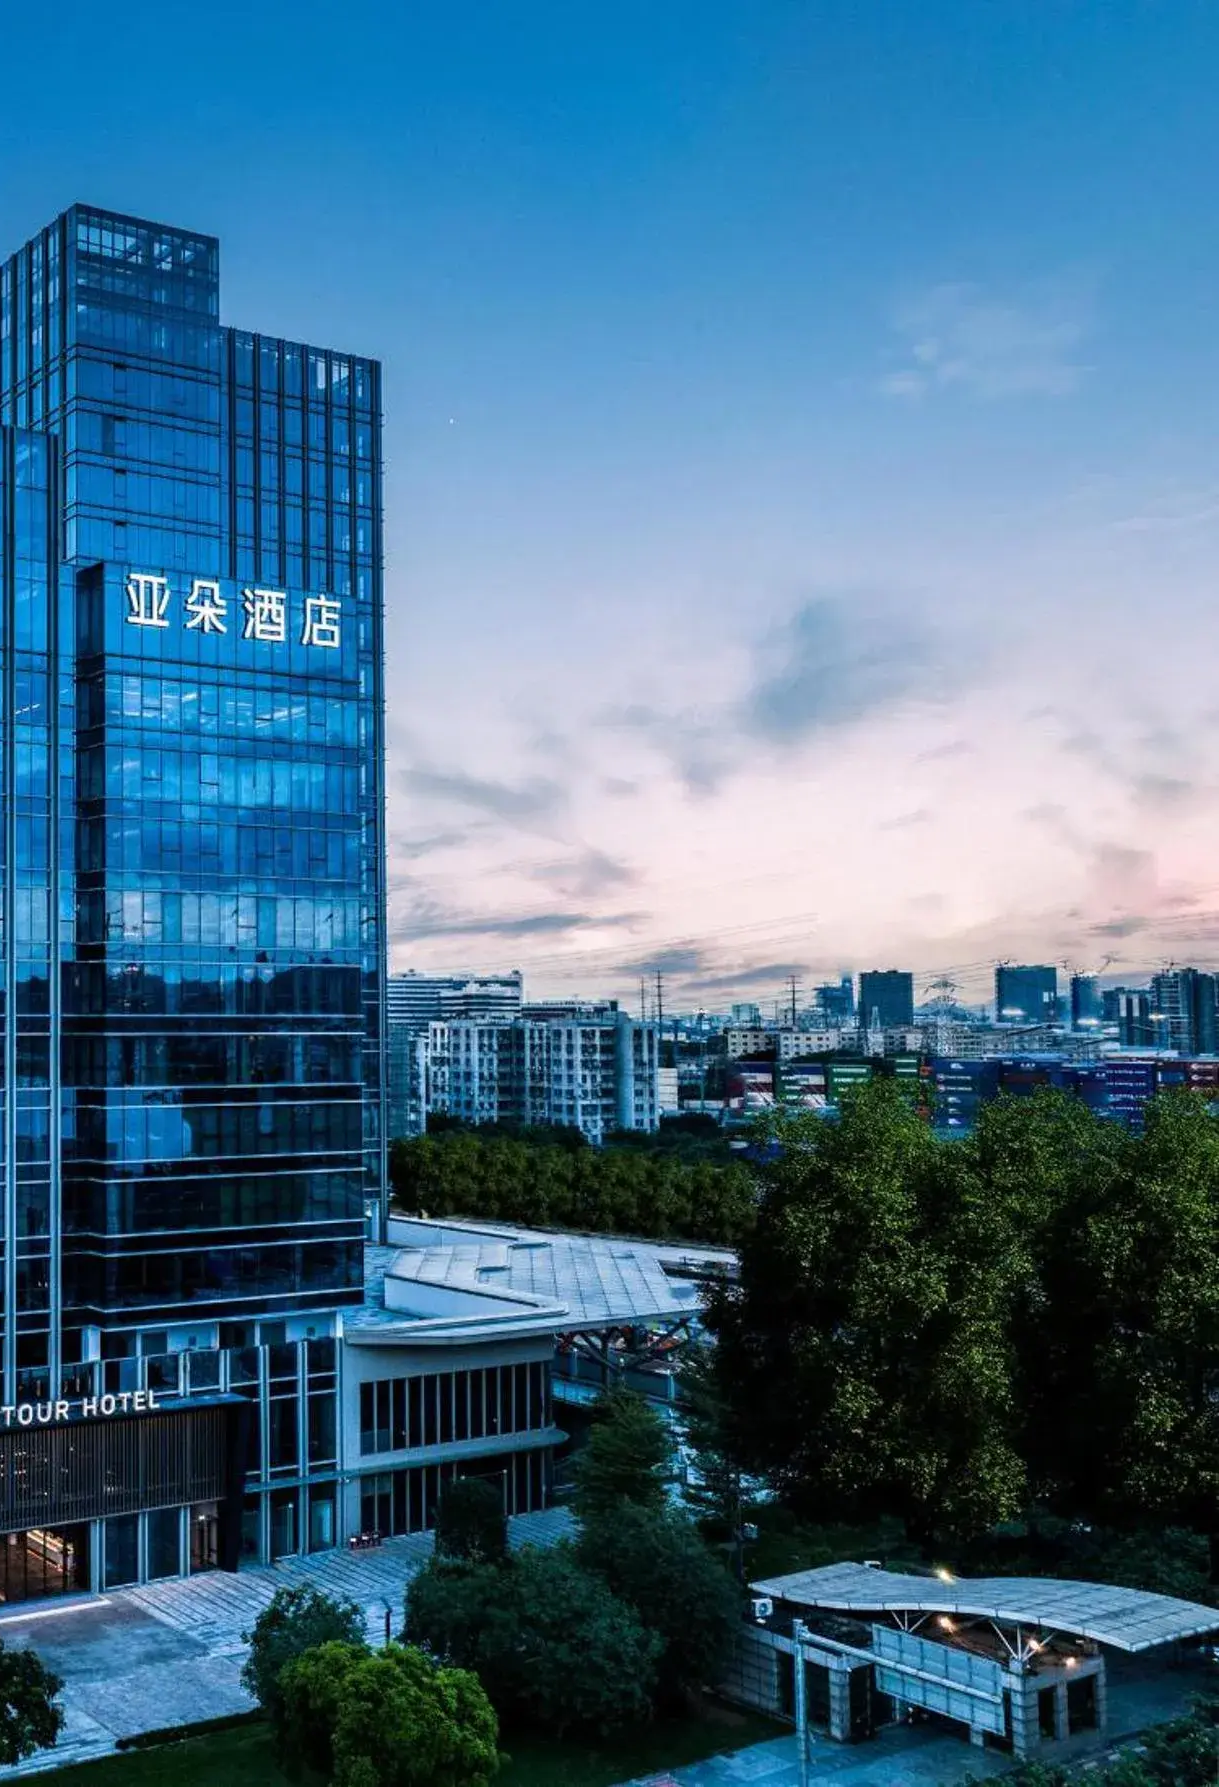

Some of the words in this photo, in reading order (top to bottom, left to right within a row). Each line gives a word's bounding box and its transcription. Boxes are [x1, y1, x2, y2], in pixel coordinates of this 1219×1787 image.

[127, 573, 342, 648] 亚朵酒店
[82, 1390, 161, 1417] HOTEL
